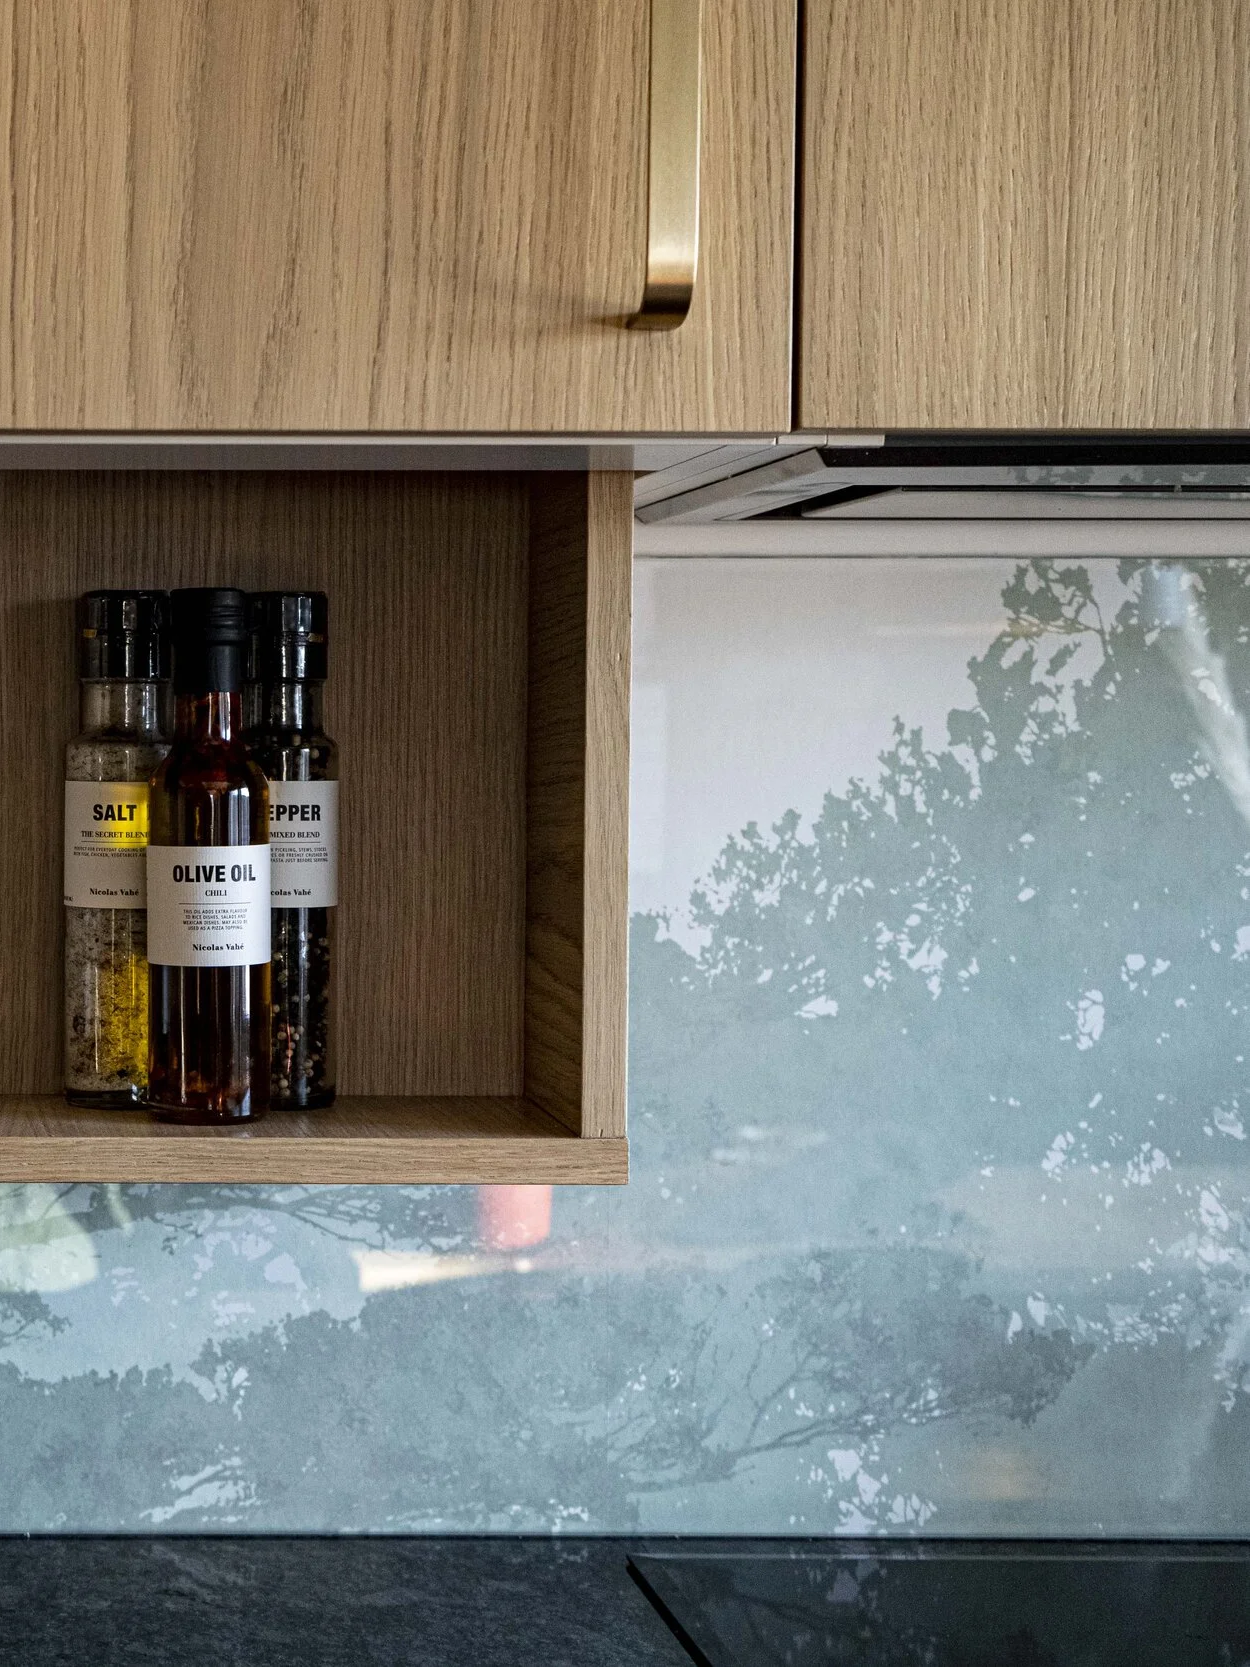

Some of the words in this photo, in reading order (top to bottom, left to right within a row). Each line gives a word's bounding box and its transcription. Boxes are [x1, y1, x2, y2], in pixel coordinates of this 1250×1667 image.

[93, 804, 137, 821] SALT
[269, 804, 321, 821] EPPER
[81, 830, 95, 838] THE
[269, 831, 296, 839] MIXED
[172, 864, 226, 883] OLIVE
[231, 864, 256, 882] OIL
[89, 888, 118, 896] Nicolas
[119, 888, 139, 896] Vahé
[205, 889, 227, 897] CHILI
[270, 888, 291, 896] colas
[293, 888, 312, 896] Vahé
[192, 943, 224, 951] Nicolas
[225, 942, 245, 951] Vahé
